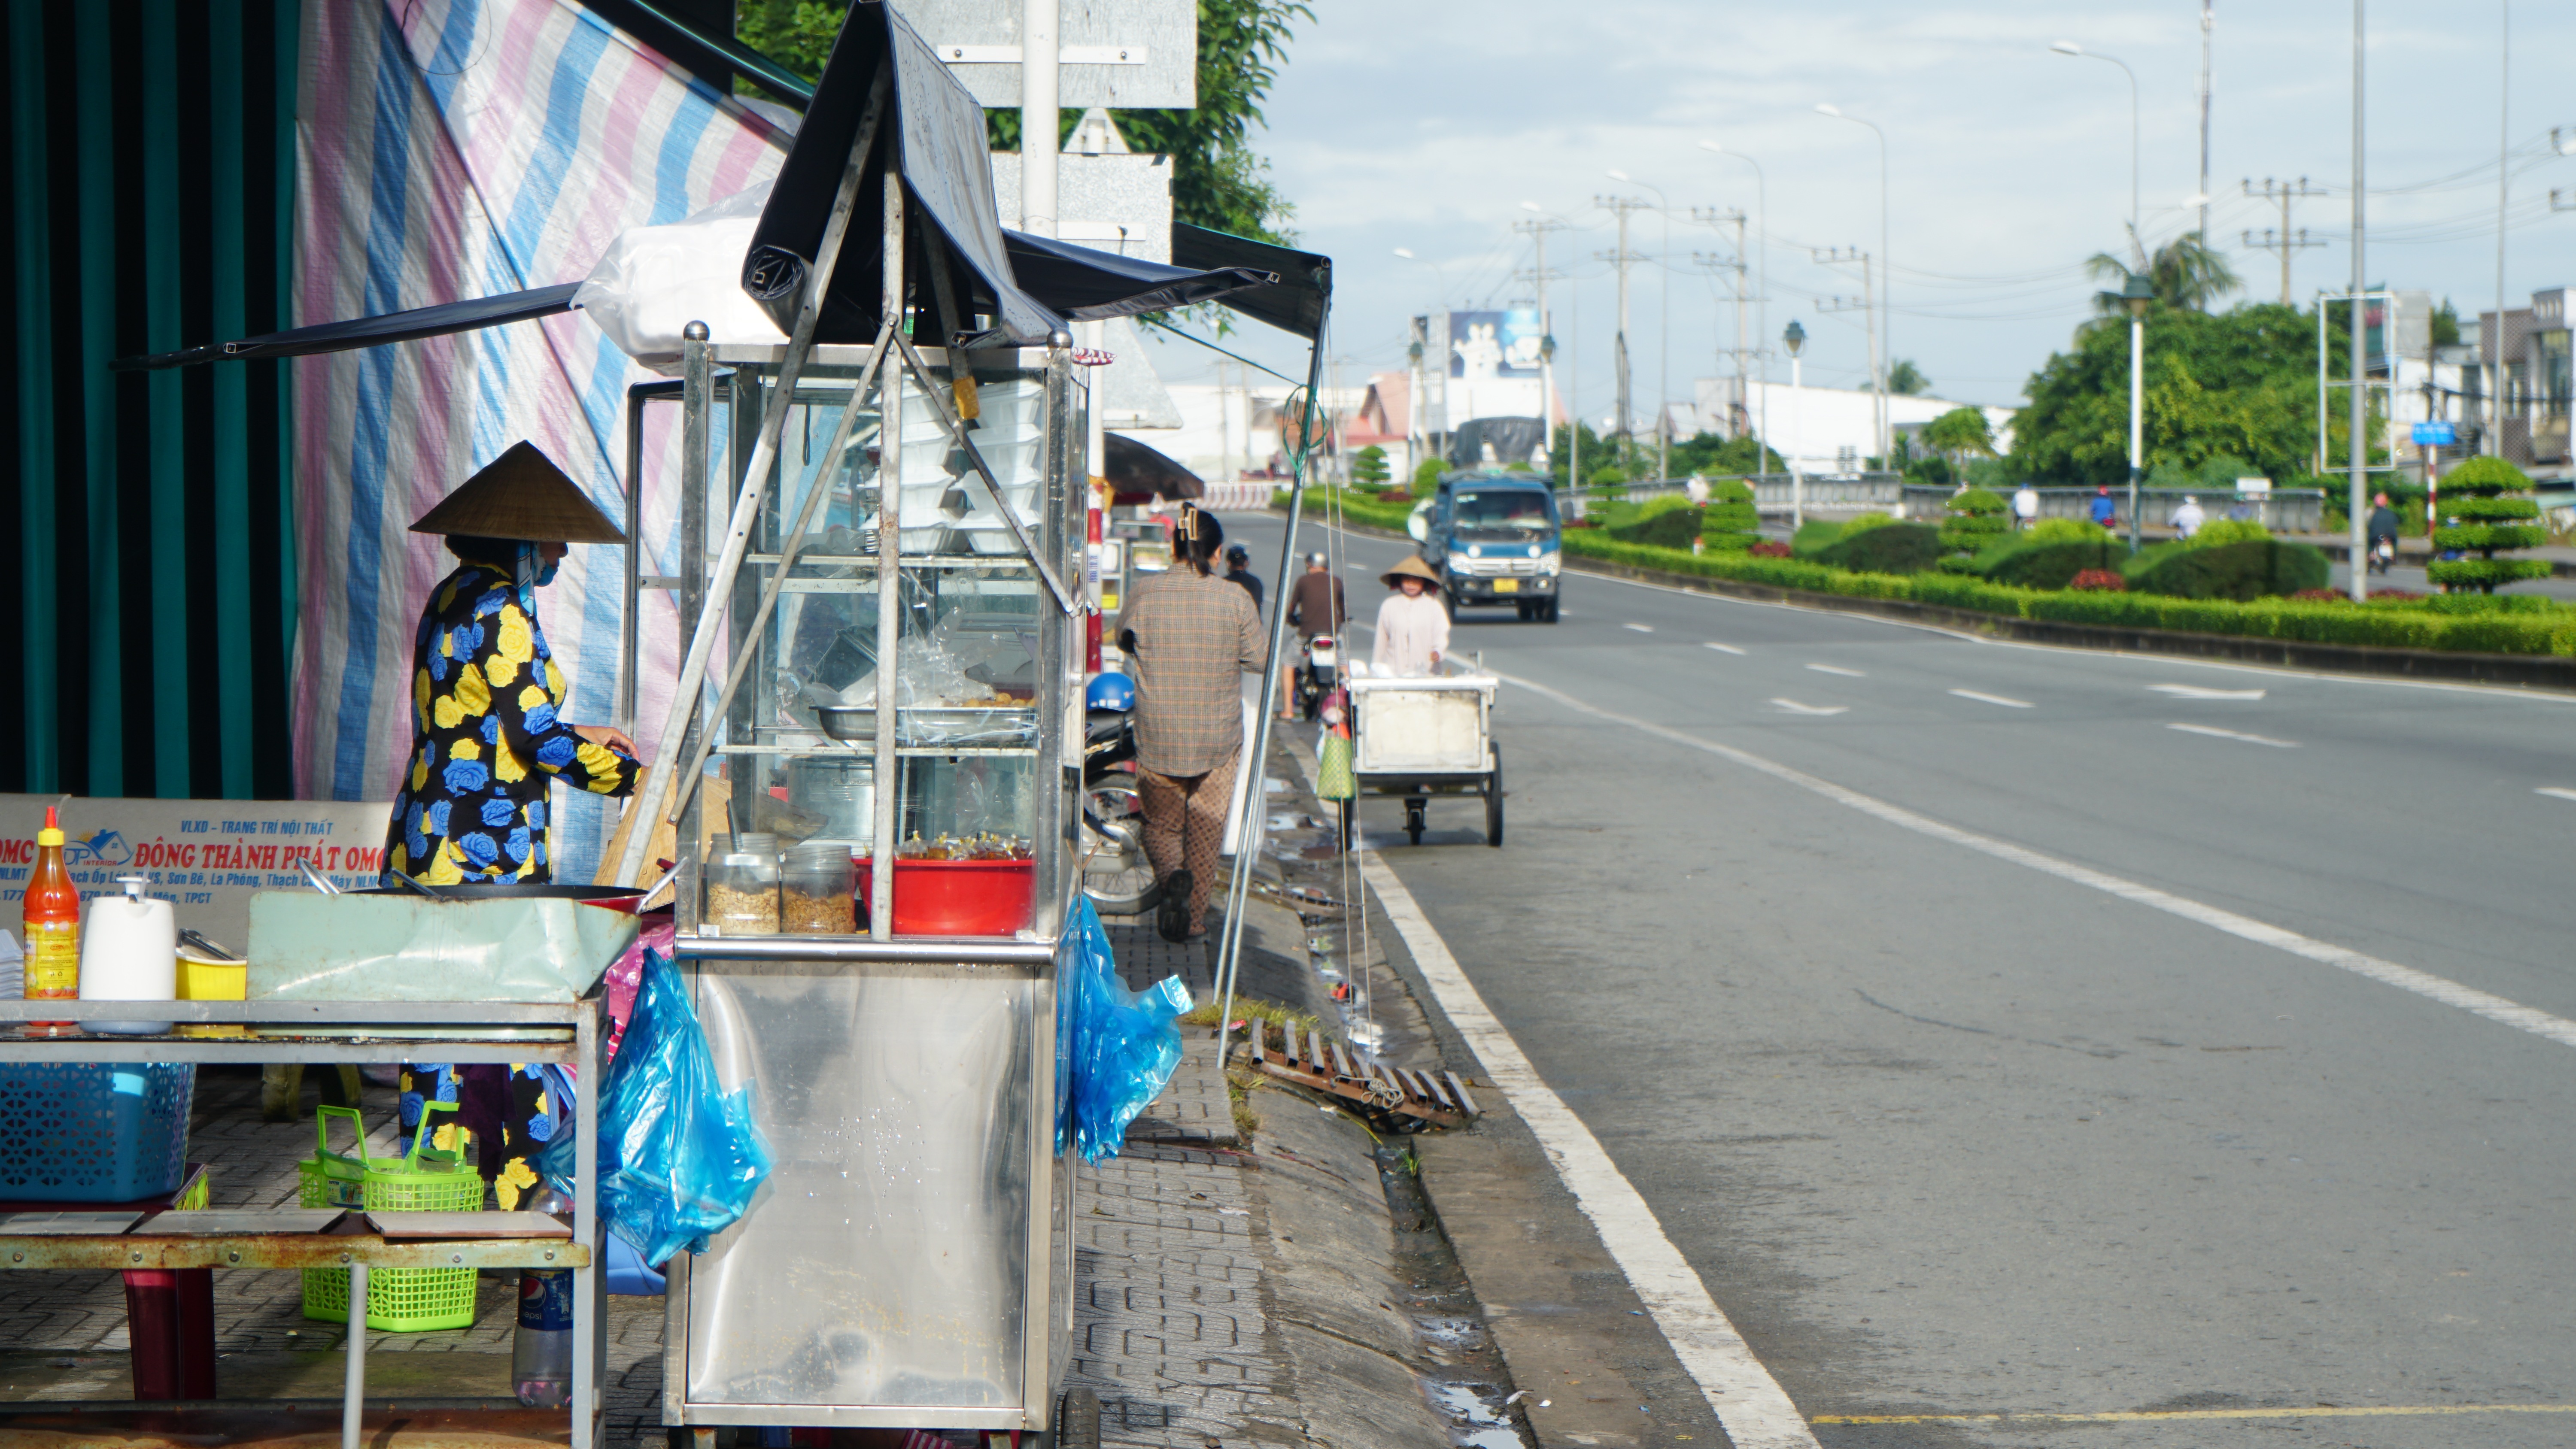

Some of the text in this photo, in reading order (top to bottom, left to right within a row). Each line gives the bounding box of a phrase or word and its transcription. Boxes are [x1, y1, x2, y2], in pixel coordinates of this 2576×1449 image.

[181, 820, 209, 833] VLXD
[221, 821, 257, 834] TRANG
[261, 819, 279, 834] TRÍ
[280, 819, 301, 837] NỘI
[305, 818, 333, 835] THẤT
[0, 838, 35, 864] MC
[134, 835, 196, 868] ĐÔNG
[202, 837, 278, 870] THÀNH
[281, 839, 341, 871] PHÁT
[91, 867, 106, 885] Ốp
[167, 872, 187, 885] Sơn
[210, 873, 224, 885] La
[267, 874, 298, 889] Thạch
[329, 875, 352, 889] Máy
[185, 892, 213, 903] TPCT
